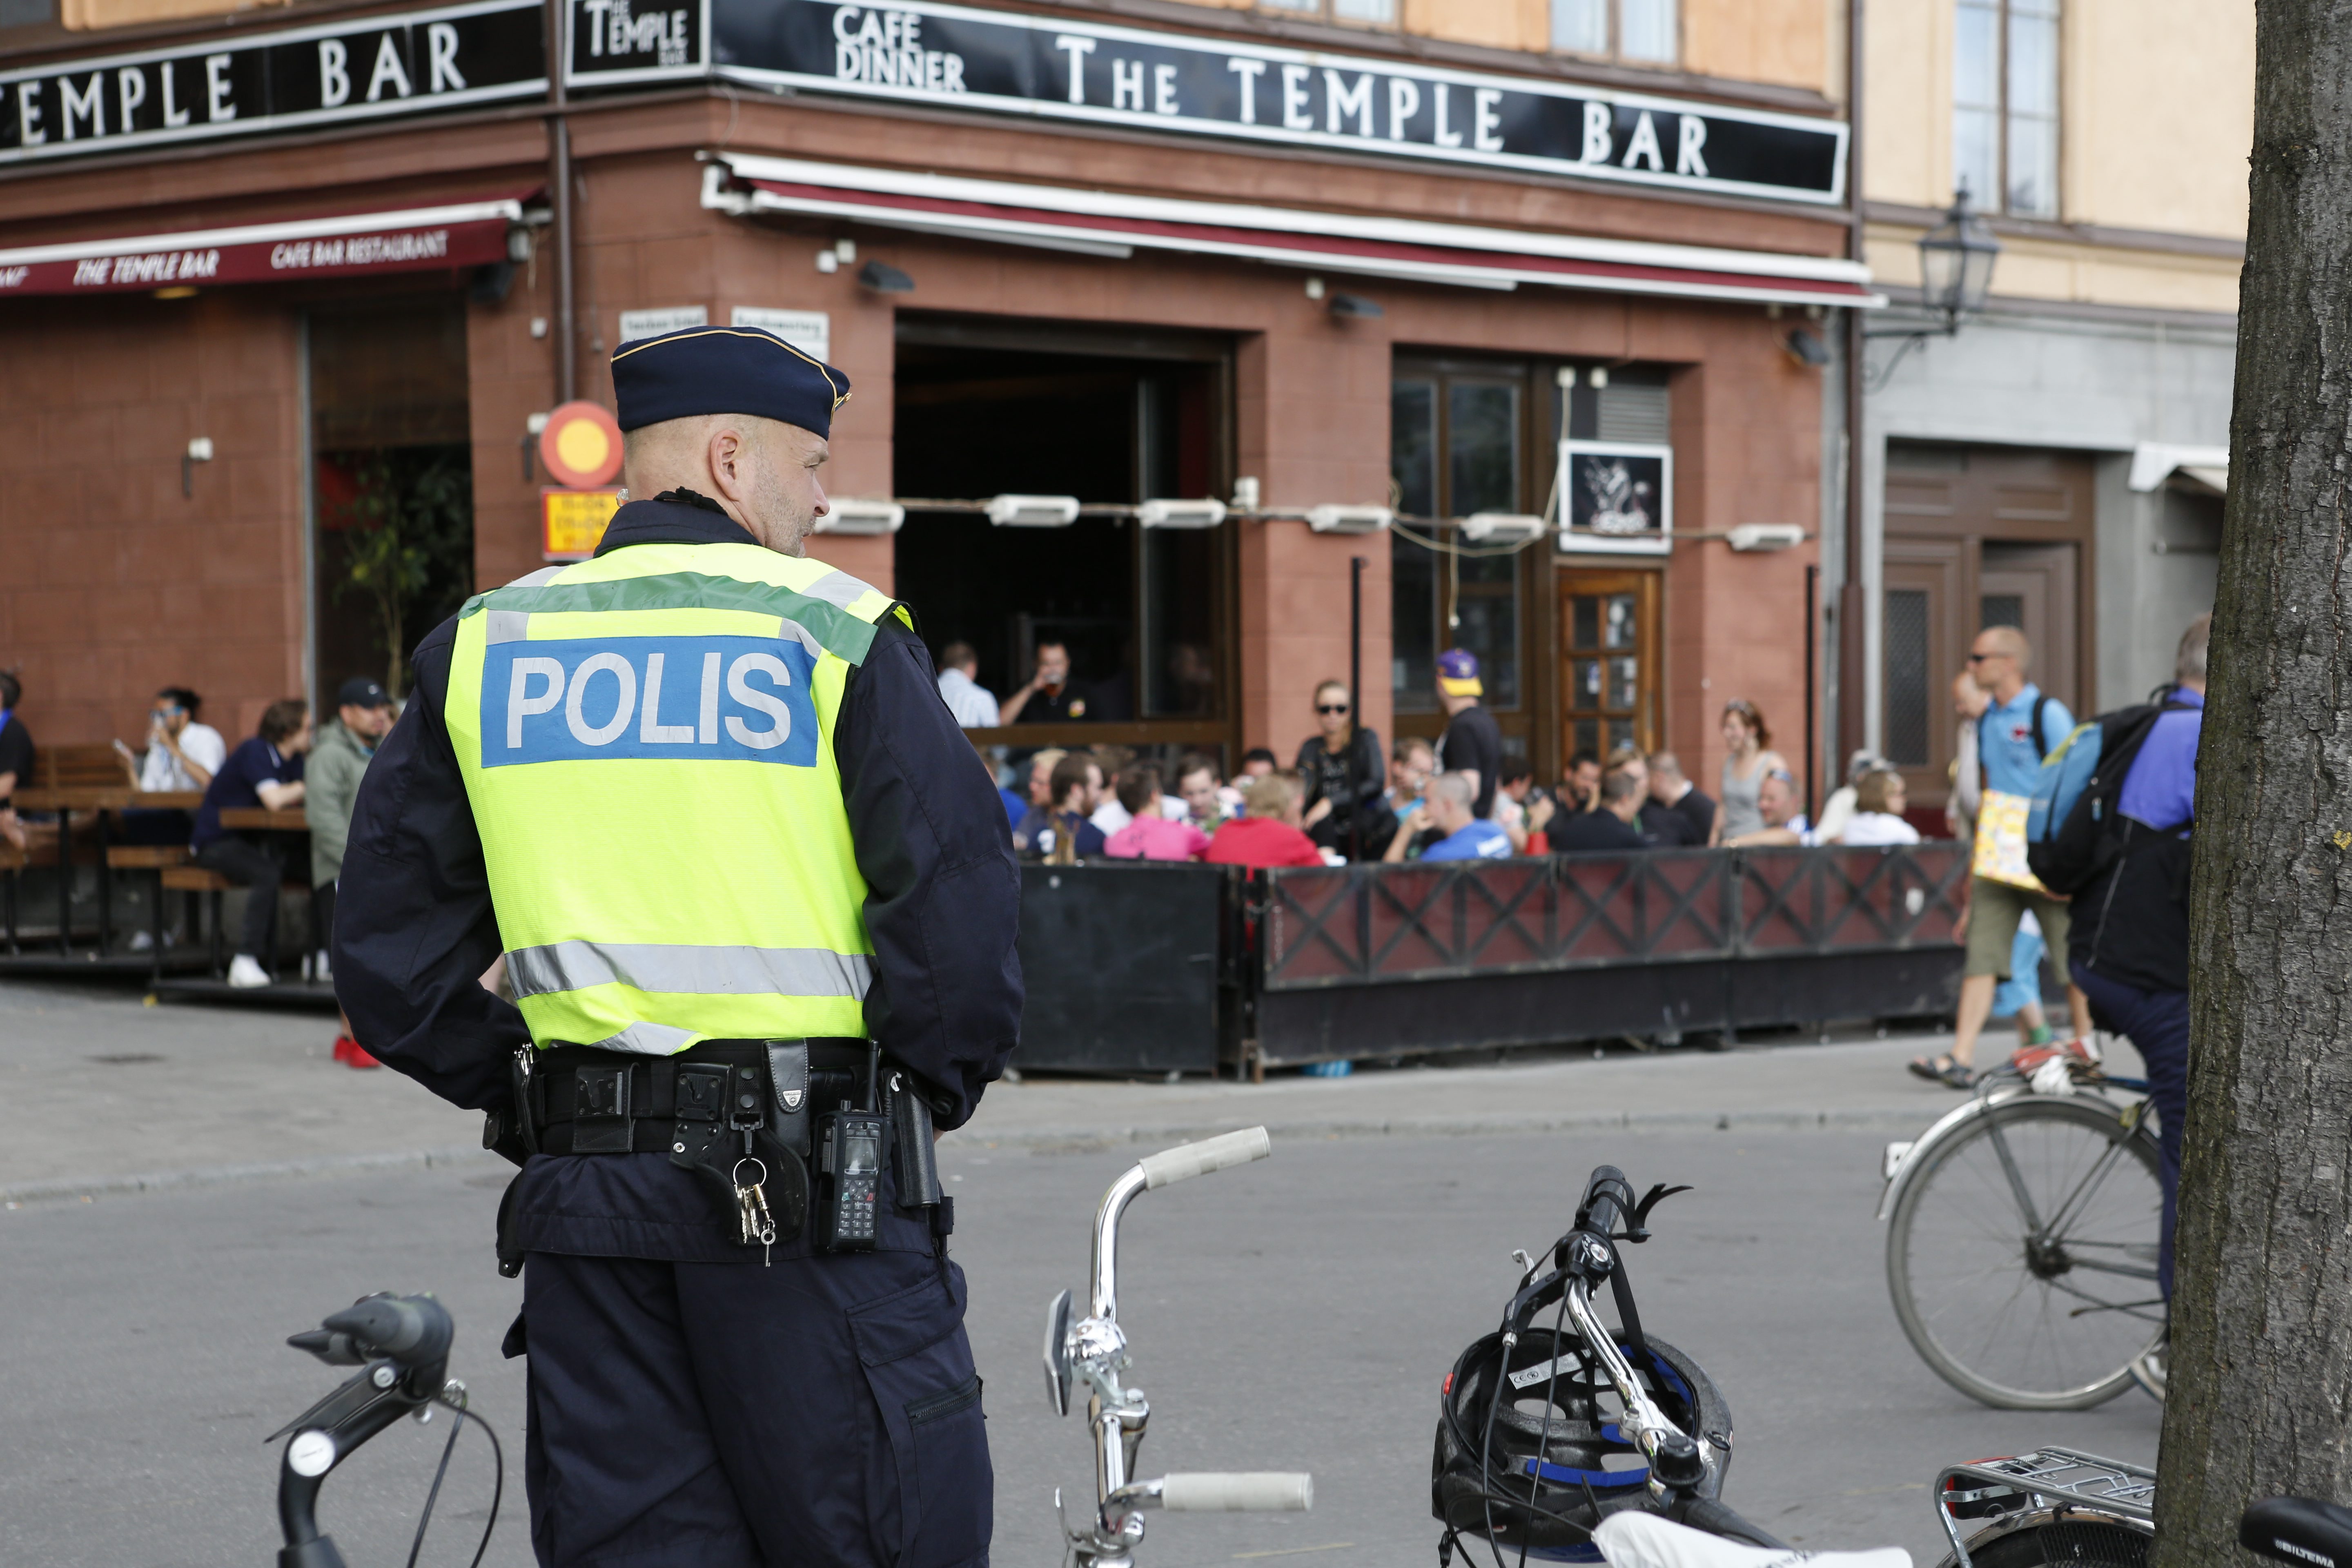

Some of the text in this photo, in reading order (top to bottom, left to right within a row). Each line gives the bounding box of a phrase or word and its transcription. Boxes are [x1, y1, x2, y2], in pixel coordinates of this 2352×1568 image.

[583, 1, 689, 56] TEMPLE
[833, 4, 924, 53] CAFE
[0, 21, 467, 145] EMPLE BAR
[836, 42, 967, 92] DINNER
[1055, 34, 1710, 177] THE TEMPLE BAR
[73, 249, 220, 286] THE TEMPLE BAR
[271, 229, 448, 270] CAFE BAR RESTAURANT
[507, 653, 791, 750] POLIS
[2282, 1541, 2335, 1568] BILTEMA
